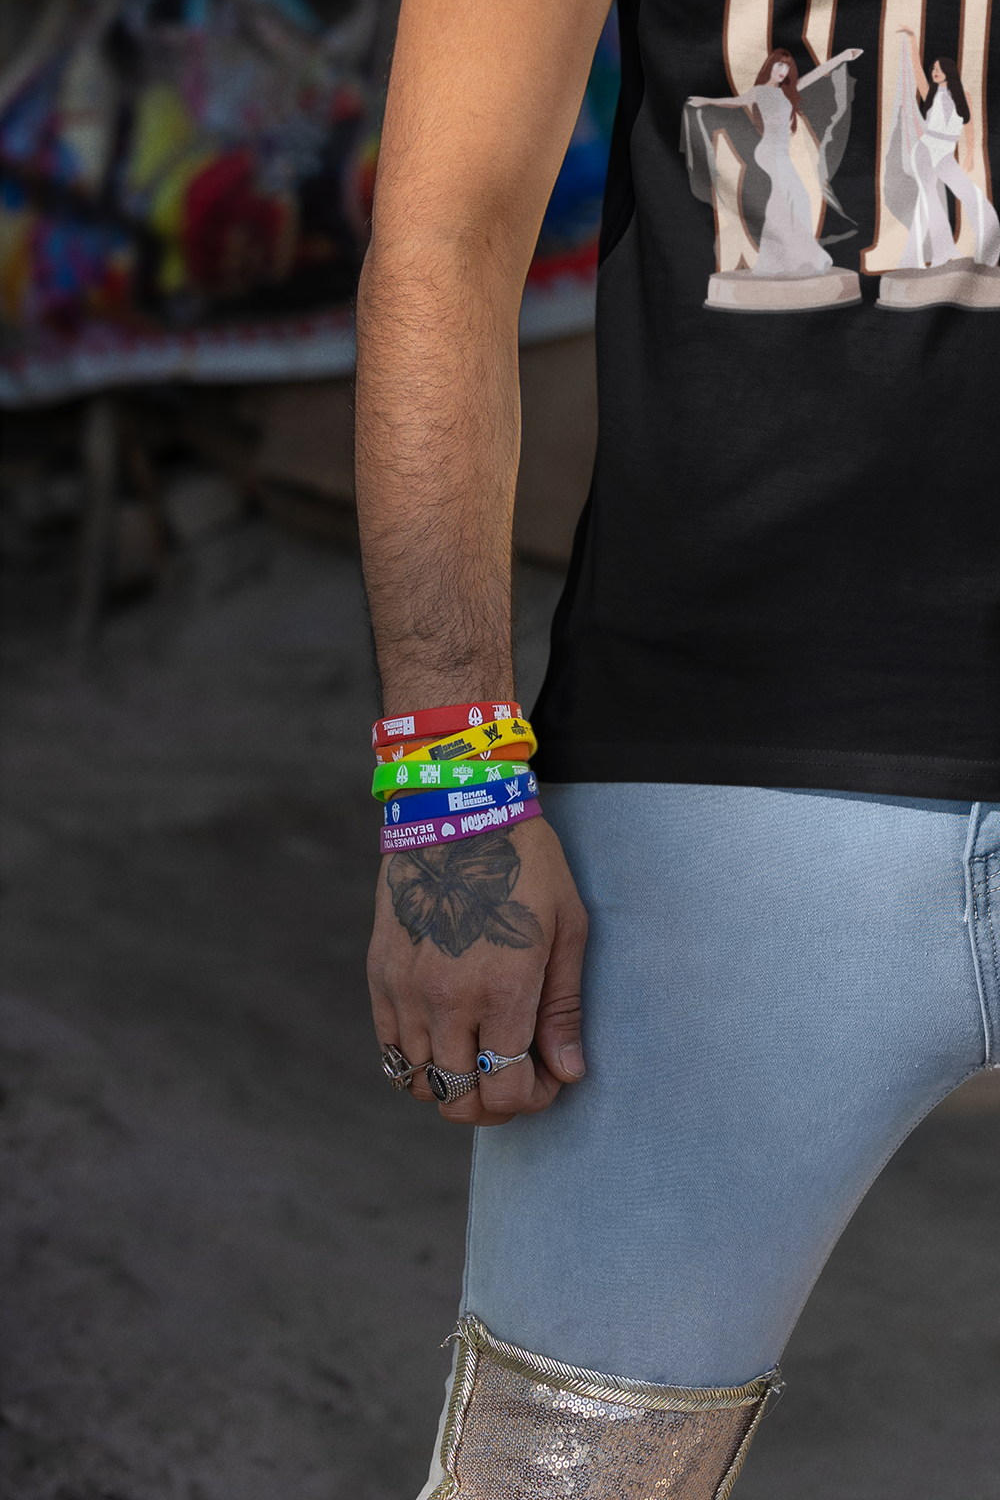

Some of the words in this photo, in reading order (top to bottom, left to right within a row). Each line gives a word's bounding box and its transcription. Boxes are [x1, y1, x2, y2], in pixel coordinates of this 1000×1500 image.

[461, 806, 508, 834] DIRECTION
[383, 823, 434, 839] BEAUTIFUL
[384, 840, 395, 849] YOU
[395, 836, 417, 848] MAKES
[417, 833, 438, 845] WHAT
